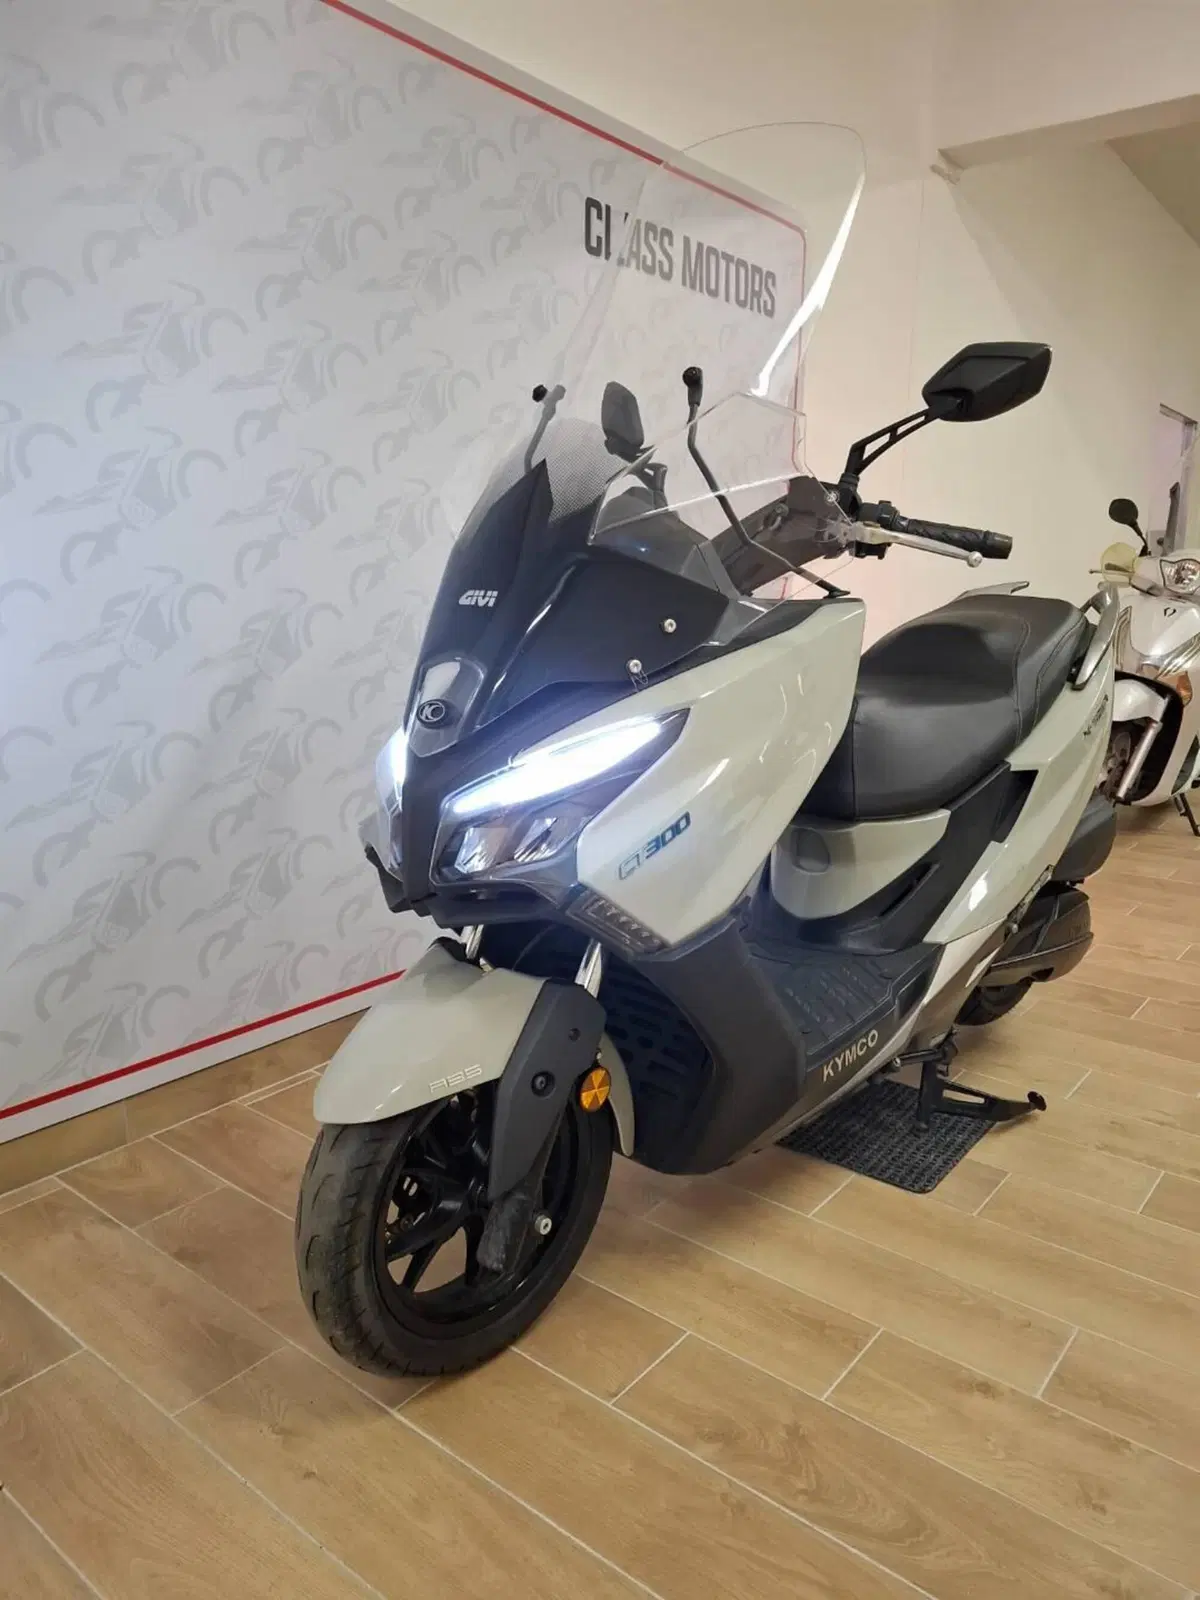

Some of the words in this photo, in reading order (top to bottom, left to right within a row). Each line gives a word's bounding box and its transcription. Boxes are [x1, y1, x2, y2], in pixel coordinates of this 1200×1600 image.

[681, 234, 776, 318] MOTORS
[458, 589, 499, 607] GIVI
[823, 1029, 879, 1082] KYMCO
[429, 1064, 483, 1093] ABS
